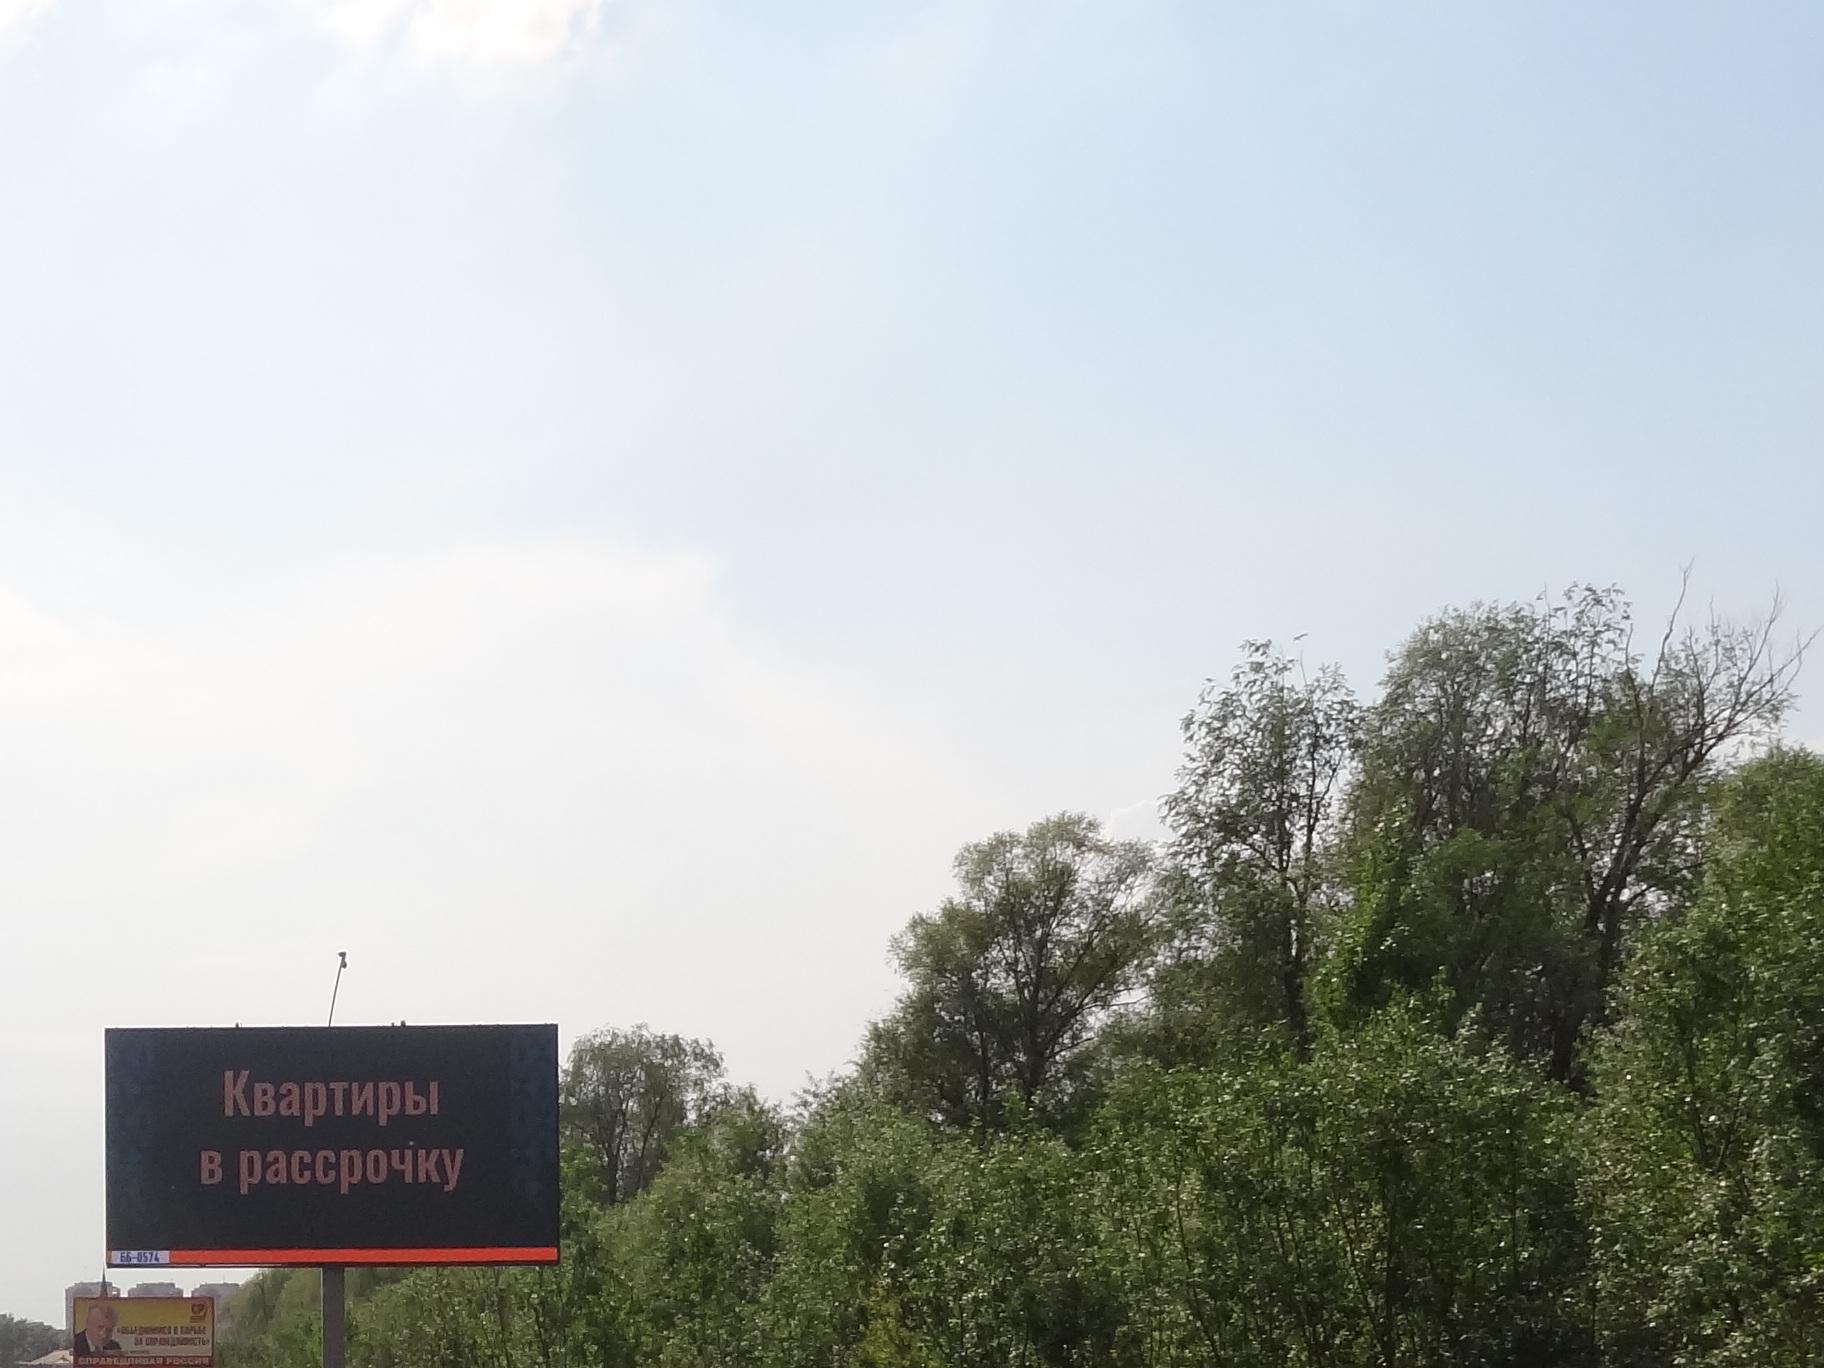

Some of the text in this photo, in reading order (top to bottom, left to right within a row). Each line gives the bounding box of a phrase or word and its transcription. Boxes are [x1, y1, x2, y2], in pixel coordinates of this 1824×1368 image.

[223, 1070, 440, 1127] Квартиры
[200, 1146, 464, 1195] в рассрочку
